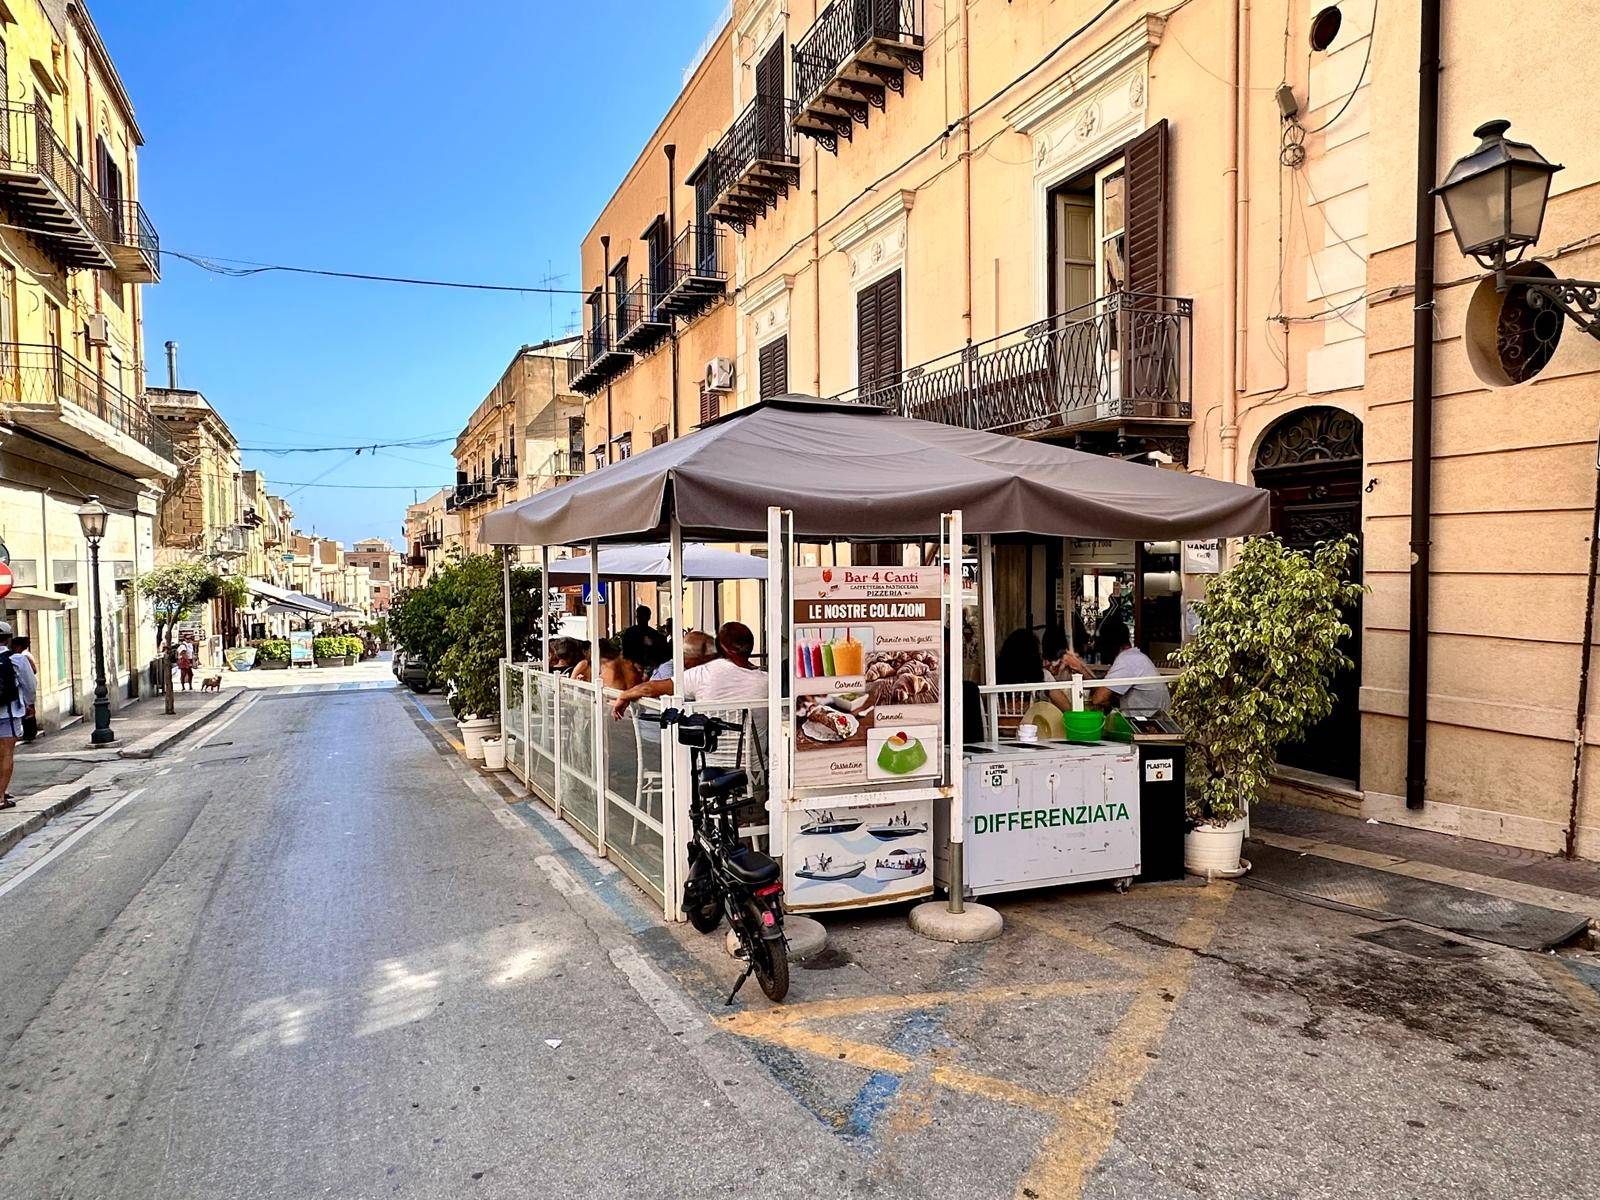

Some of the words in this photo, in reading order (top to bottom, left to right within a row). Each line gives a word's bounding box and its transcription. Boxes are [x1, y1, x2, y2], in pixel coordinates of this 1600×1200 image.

[844, 571, 868, 583] Bar
[871, 571, 879, 583] 4
[884, 571, 918, 583] Canti
[809, 604, 822, 619] LE
[824, 603, 867, 619] NOSTRE
[869, 602, 926, 618] COLAZIONI
[834, 681, 862, 689] Cornetti
[876, 712, 903, 721] Cannoli
[1146, 762, 1172, 770] PLASTICA
[974, 803, 1130, 834] DIFFERENZIATA
